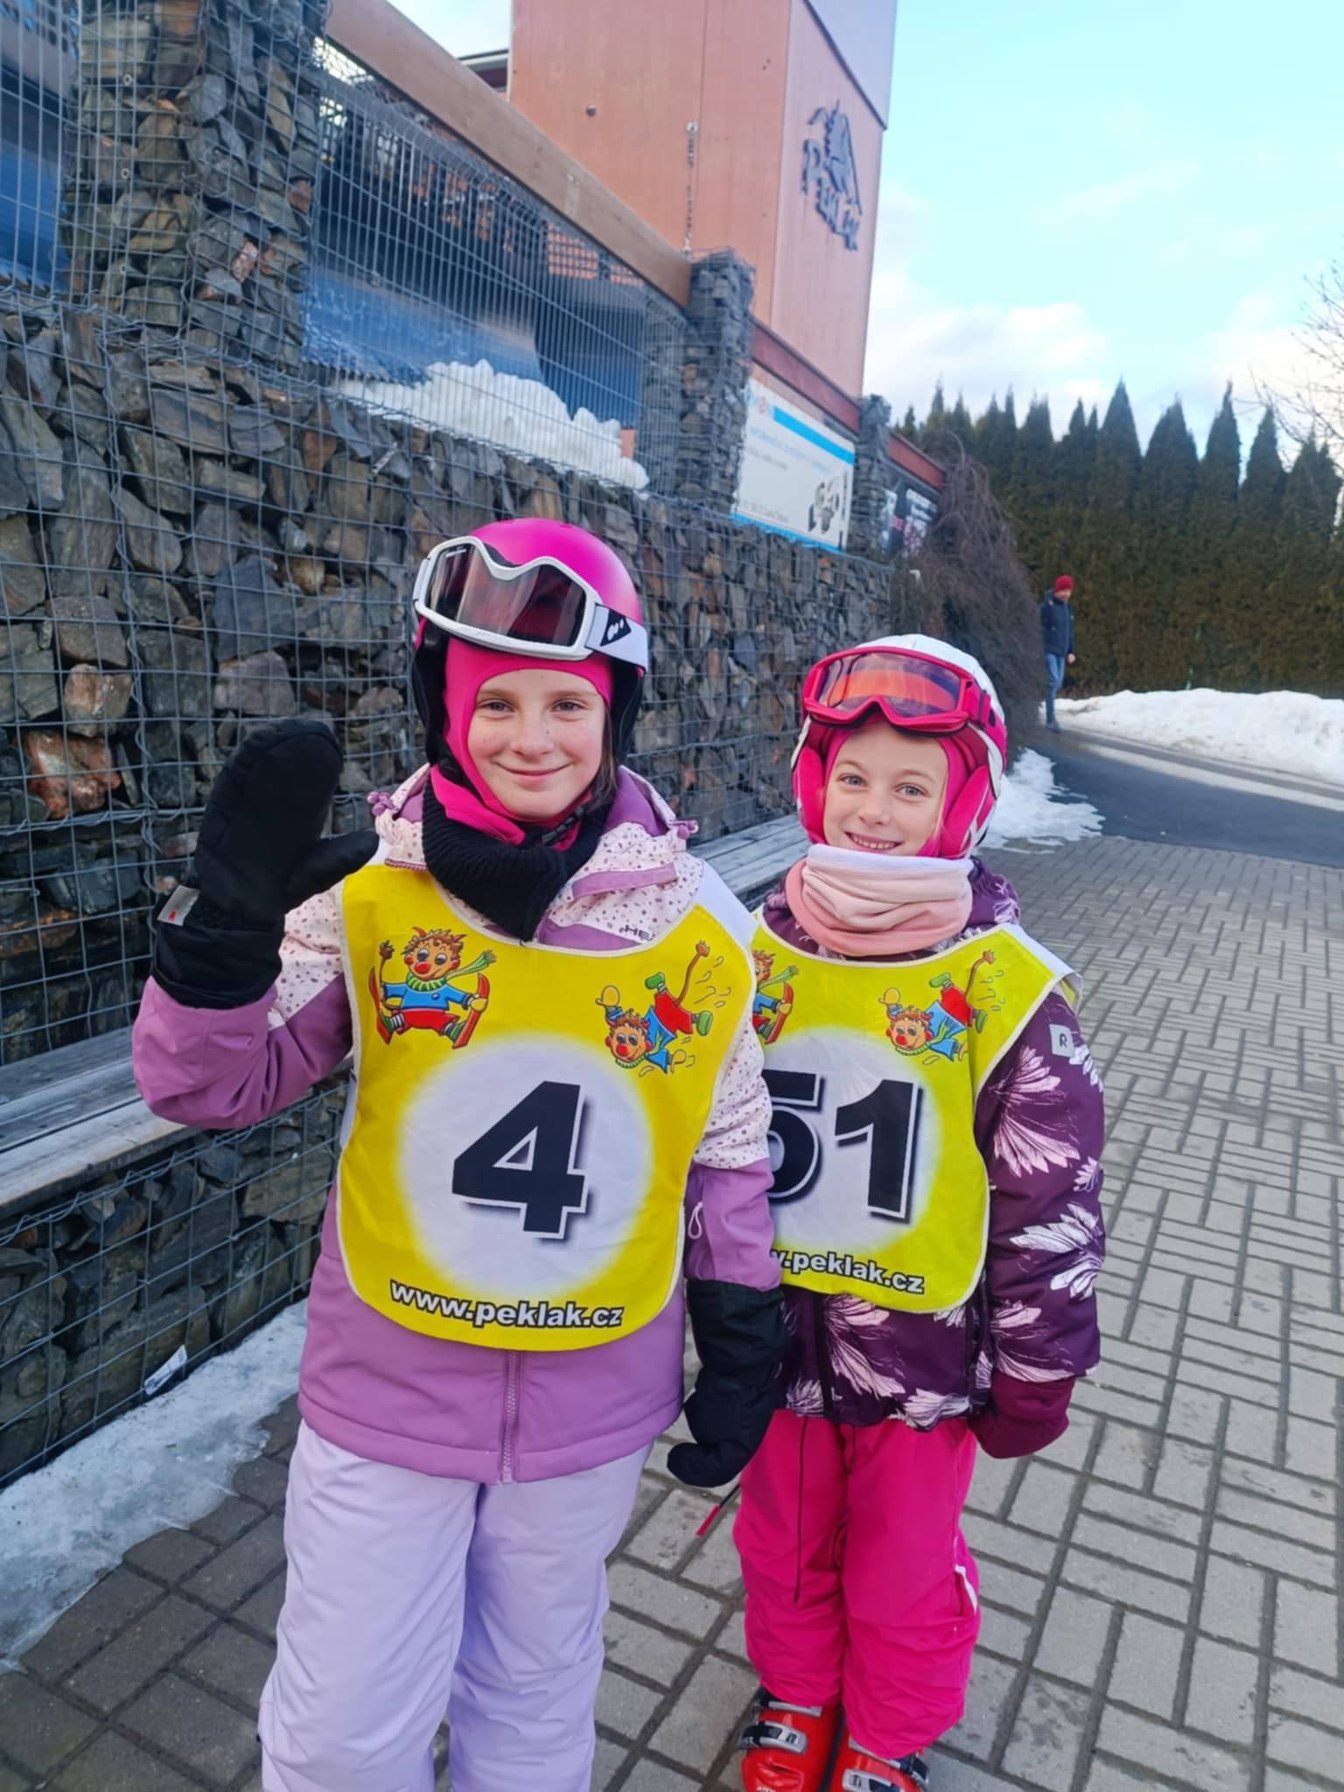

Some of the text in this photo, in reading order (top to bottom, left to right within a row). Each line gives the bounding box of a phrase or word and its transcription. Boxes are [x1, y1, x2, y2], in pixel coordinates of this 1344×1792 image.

[452, 1081, 589, 1239] 4
[762, 1069, 920, 1221] 51
[390, 1279, 625, 1328] www.peklak.cz
